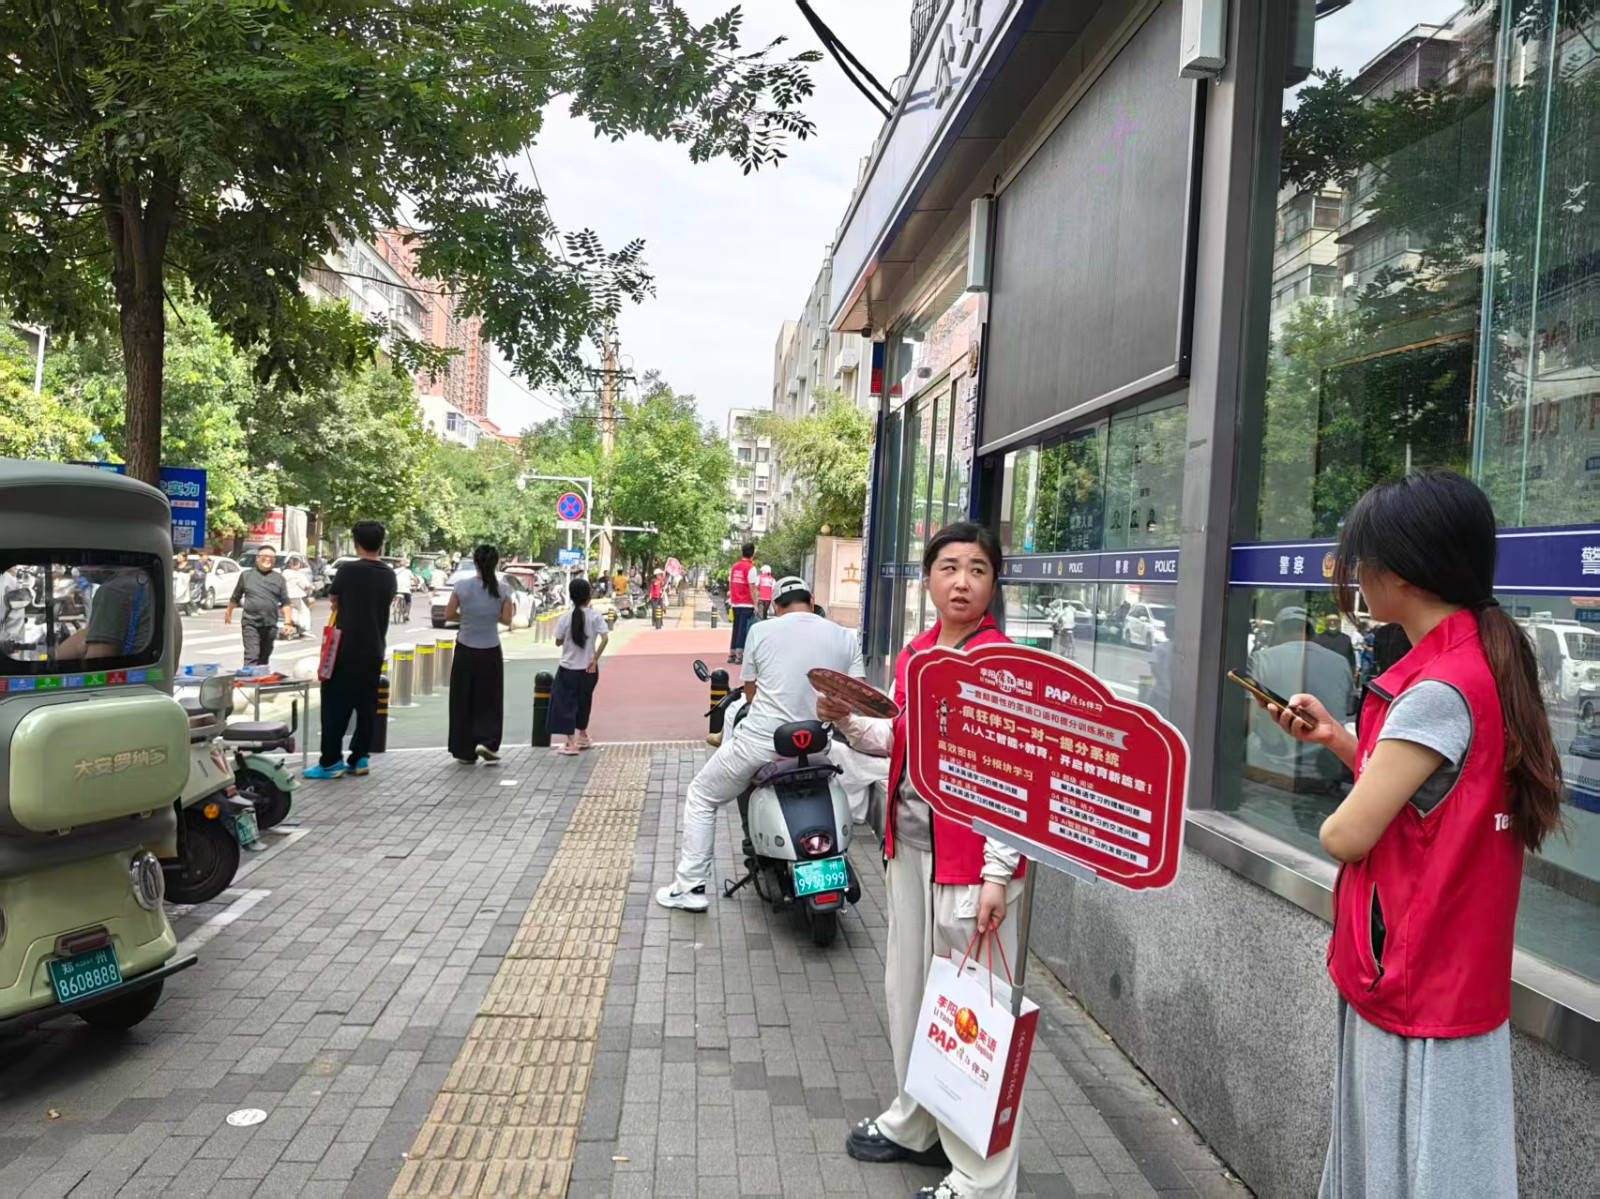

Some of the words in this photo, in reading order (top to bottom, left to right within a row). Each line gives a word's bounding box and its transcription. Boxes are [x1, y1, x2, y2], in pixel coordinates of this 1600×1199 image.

[1068, 562, 1084, 573] POLICE
[1115, 559, 1129, 574] 警察
[1154, 560, 1176, 573] POLICE
[1279, 555, 1305, 575] 警察
[1045, 685, 1071, 703] PAP
[962, 705, 1120, 767] 疯狂伴习一对一提分系统
[938, 740, 977, 762] 高效密码
[982, 755, 1033, 781] 分模块学习
[1060, 805, 1139, 840] 解决英语学习的交流问题
[59, 963, 117, 997] 8608888
[927, 1022, 958, 1053] PAP
[937, 994, 958, 1017] 李阳
[978, 1028, 997, 1053] 英语
